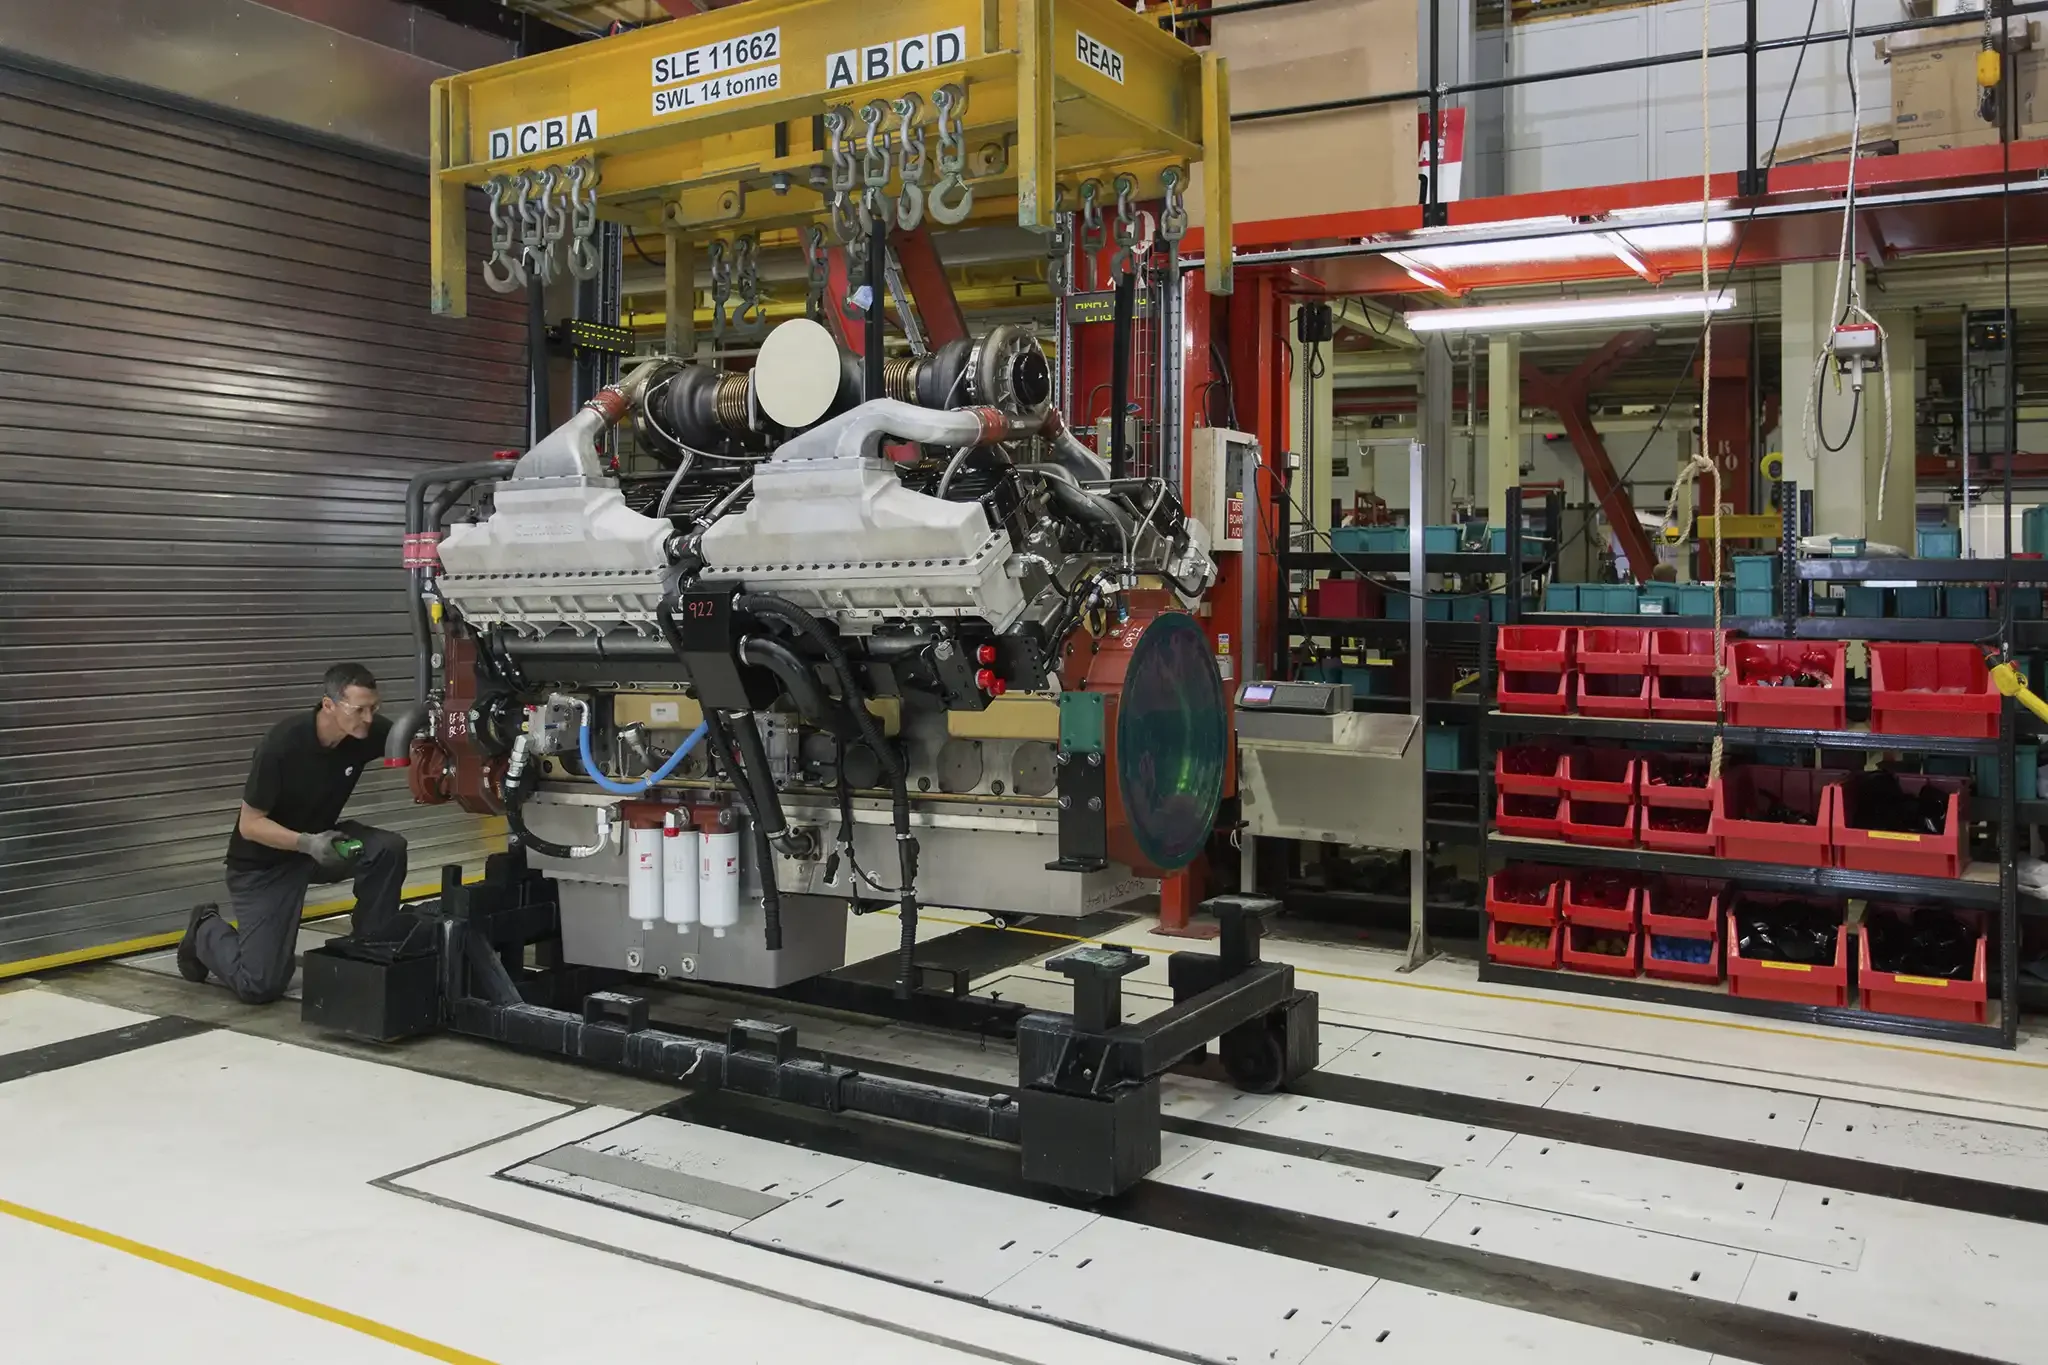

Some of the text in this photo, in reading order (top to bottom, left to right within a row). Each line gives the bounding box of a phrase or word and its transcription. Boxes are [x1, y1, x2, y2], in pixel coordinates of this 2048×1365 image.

[655, 32, 776, 83] SLE 11662
[1078, 34, 1122, 82] REAR
[655, 72, 778, 112] SWL 14 tonne
[1229, 514, 1243, 524] BOAR
[688, 601, 713, 619] 922
